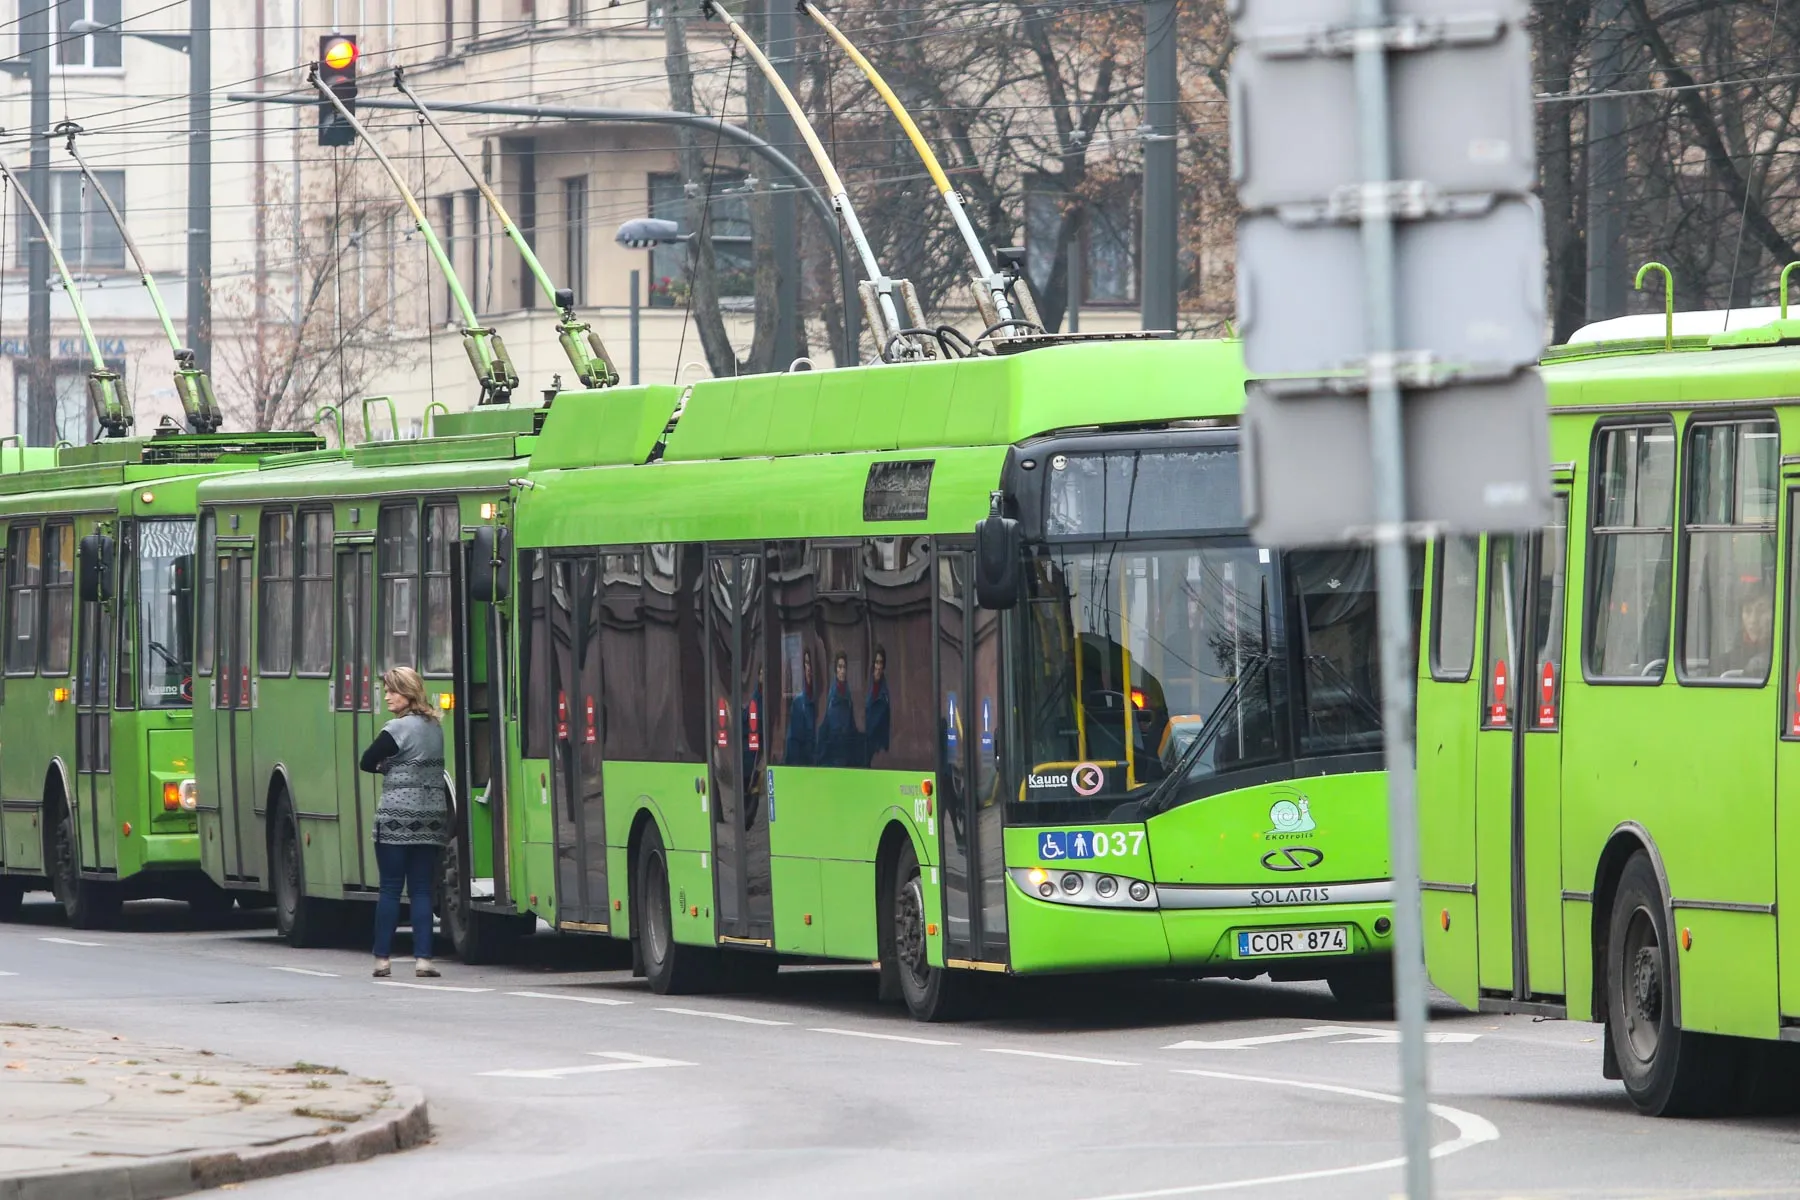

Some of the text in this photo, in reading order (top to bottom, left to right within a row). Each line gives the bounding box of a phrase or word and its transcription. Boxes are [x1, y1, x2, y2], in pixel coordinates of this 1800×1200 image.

[1028, 774, 1068, 785] Kauno
[1092, 831, 1145, 857] 037
[1251, 888, 1330, 905] SOLARIS
[1251, 930, 1344, 953] COR 874
